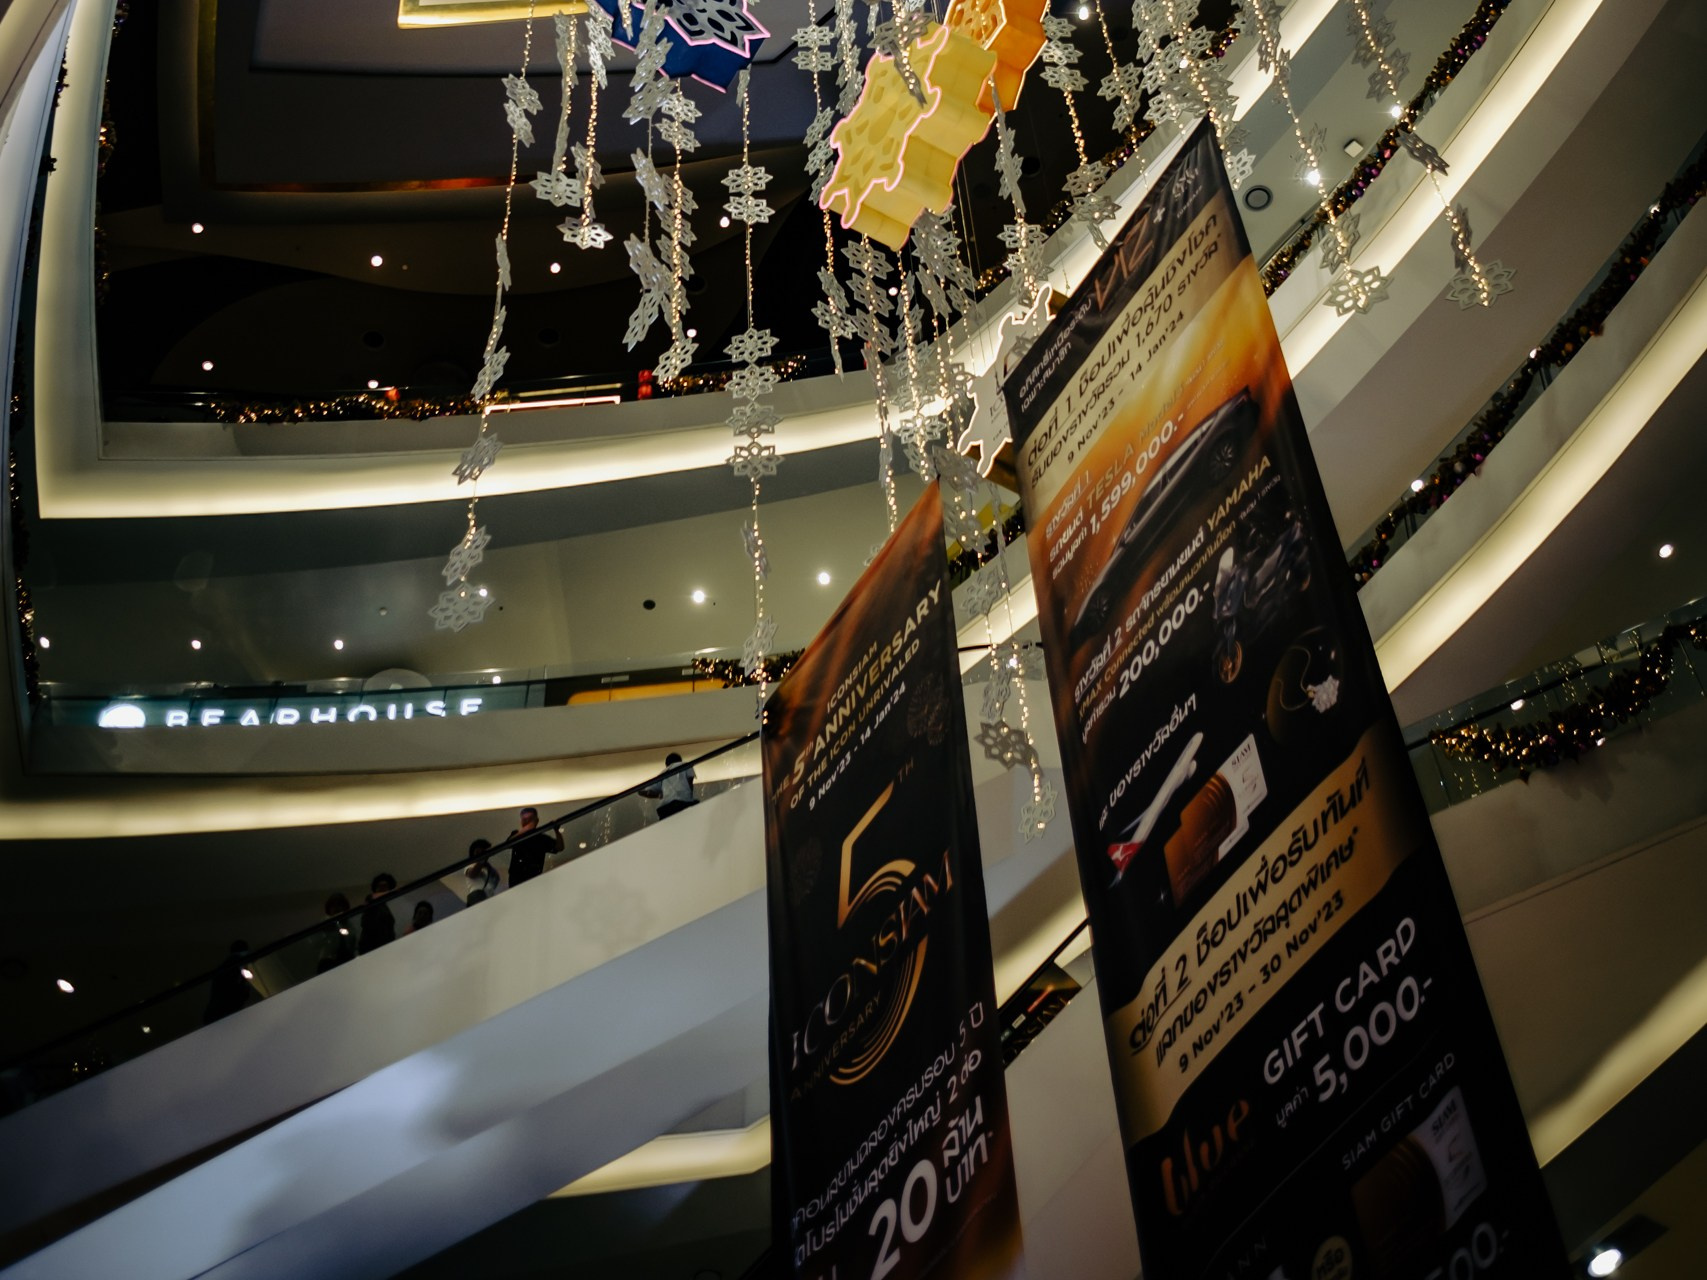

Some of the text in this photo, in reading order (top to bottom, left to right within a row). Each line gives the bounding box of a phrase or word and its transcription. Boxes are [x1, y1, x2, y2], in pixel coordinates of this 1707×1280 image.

[1135, 295, 1173, 347] 1,670
[1066, 396, 1074, 414] 1
[1067, 451, 1075, 465] 9
[1077, 400, 1116, 451] Nov'23
[1129, 364, 1143, 382] 14
[1147, 311, 1185, 362] Jan'24
[1087, 442, 1135, 511] TESLA
[1090, 413, 1184, 535] 1,599,000.-
[1114, 626, 1123, 648] 2
[1206, 455, 1272, 531] YAMAHA
[814, 579, 942, 760] ANNIVERSARY
[826, 641, 878, 714] ICONSIAM
[1104, 614, 1155, 683] Connected
[1119, 581, 1211, 699] 200,000.-
[790, 637, 920, 810] OF THE ICON UNRIVALED
[809, 796, 816, 812] 9
[818, 754, 852, 800] Nov'23
[860, 726, 872, 746] 14
[873, 681, 907, 729] Jan'24
[1175, 953, 1188, 993] 2
[1196, 756, 1371, 967] ช็อปเพื่อรับทันที
[791, 847, 953, 1072] ICONSIAM
[1179, 1053, 1189, 1074] 9
[1192, 991, 1245, 1058] Nov'23
[1260, 954, 1282, 985] 30
[1285, 889, 1344, 958] Nov'23
[1263, 916, 1417, 1086] GIFT CARD
[791, 989, 881, 1101] ANNIVERSARY
[946, 1074, 958, 1104] 2
[959, 1019, 967, 1048] 5
[1312, 975, 1434, 1103] 5,000.-
[1341, 1052, 1457, 1173] SIAM GIFT CARD
[868, 1158, 939, 1280] 20
